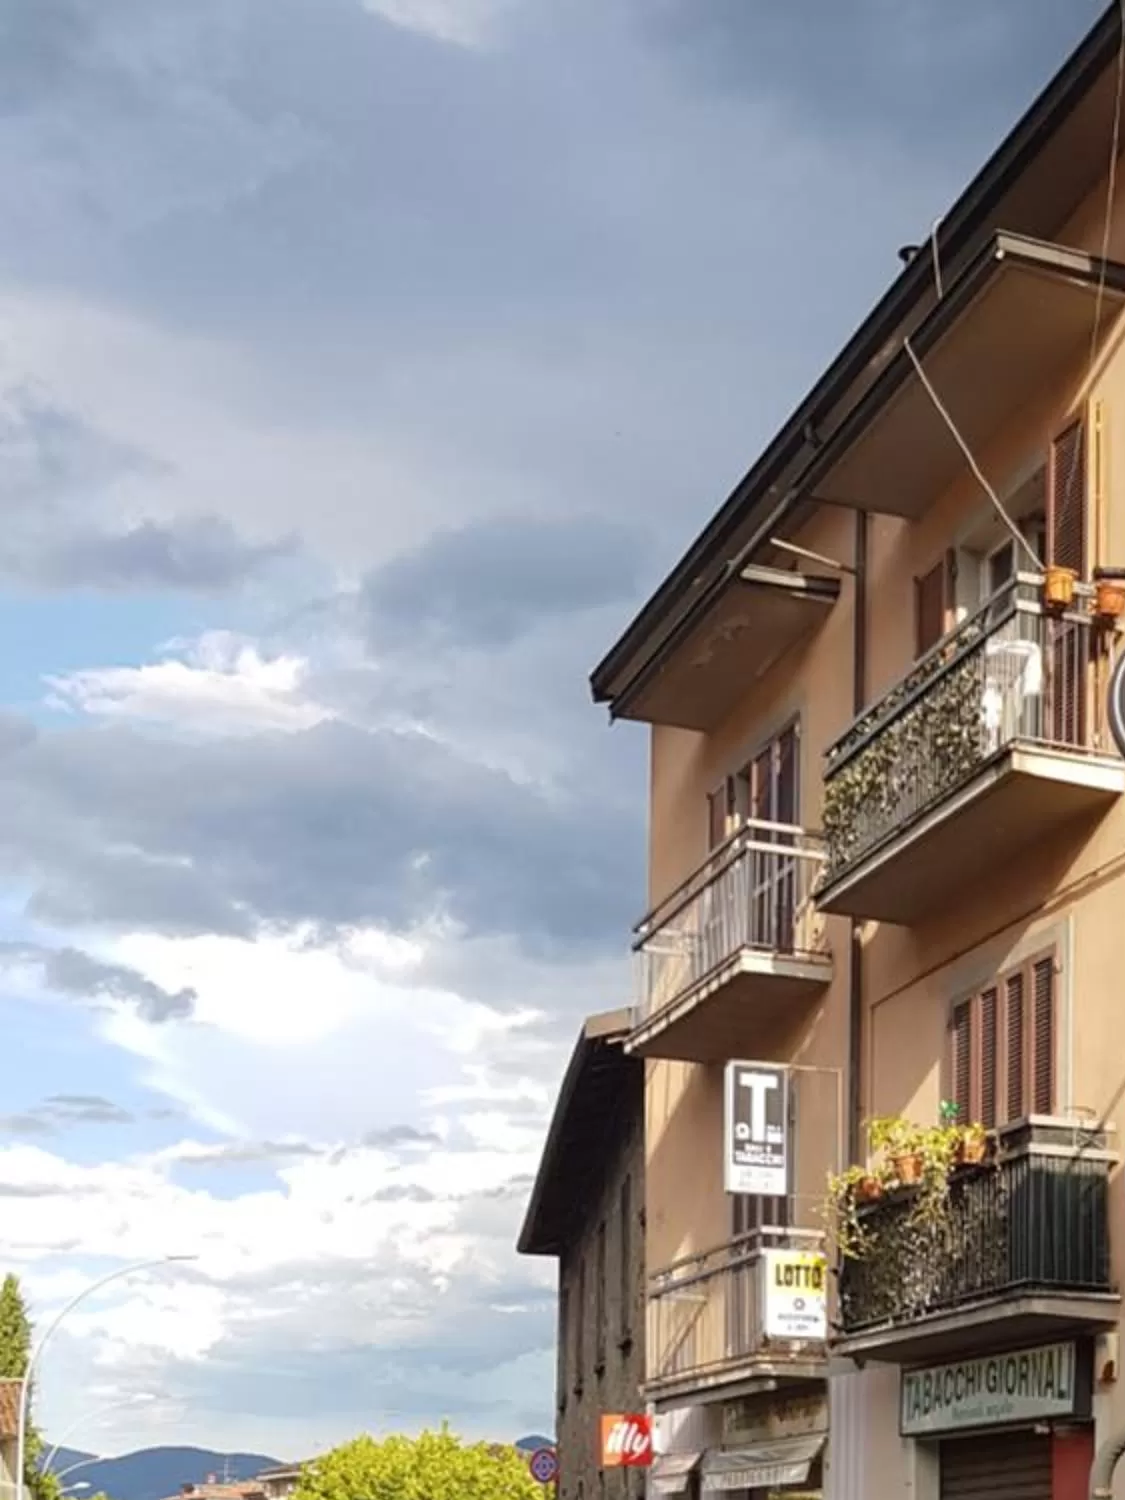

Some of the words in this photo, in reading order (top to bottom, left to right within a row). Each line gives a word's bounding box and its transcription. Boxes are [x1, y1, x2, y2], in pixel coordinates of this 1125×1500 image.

[739, 1071, 778, 1143] T
[775, 1263, 822, 1290] LOTTO
[905, 1363, 982, 1421] TABACCHI
[986, 1342, 1074, 1399] GIORNALI
[608, 1421, 650, 1460] illy
